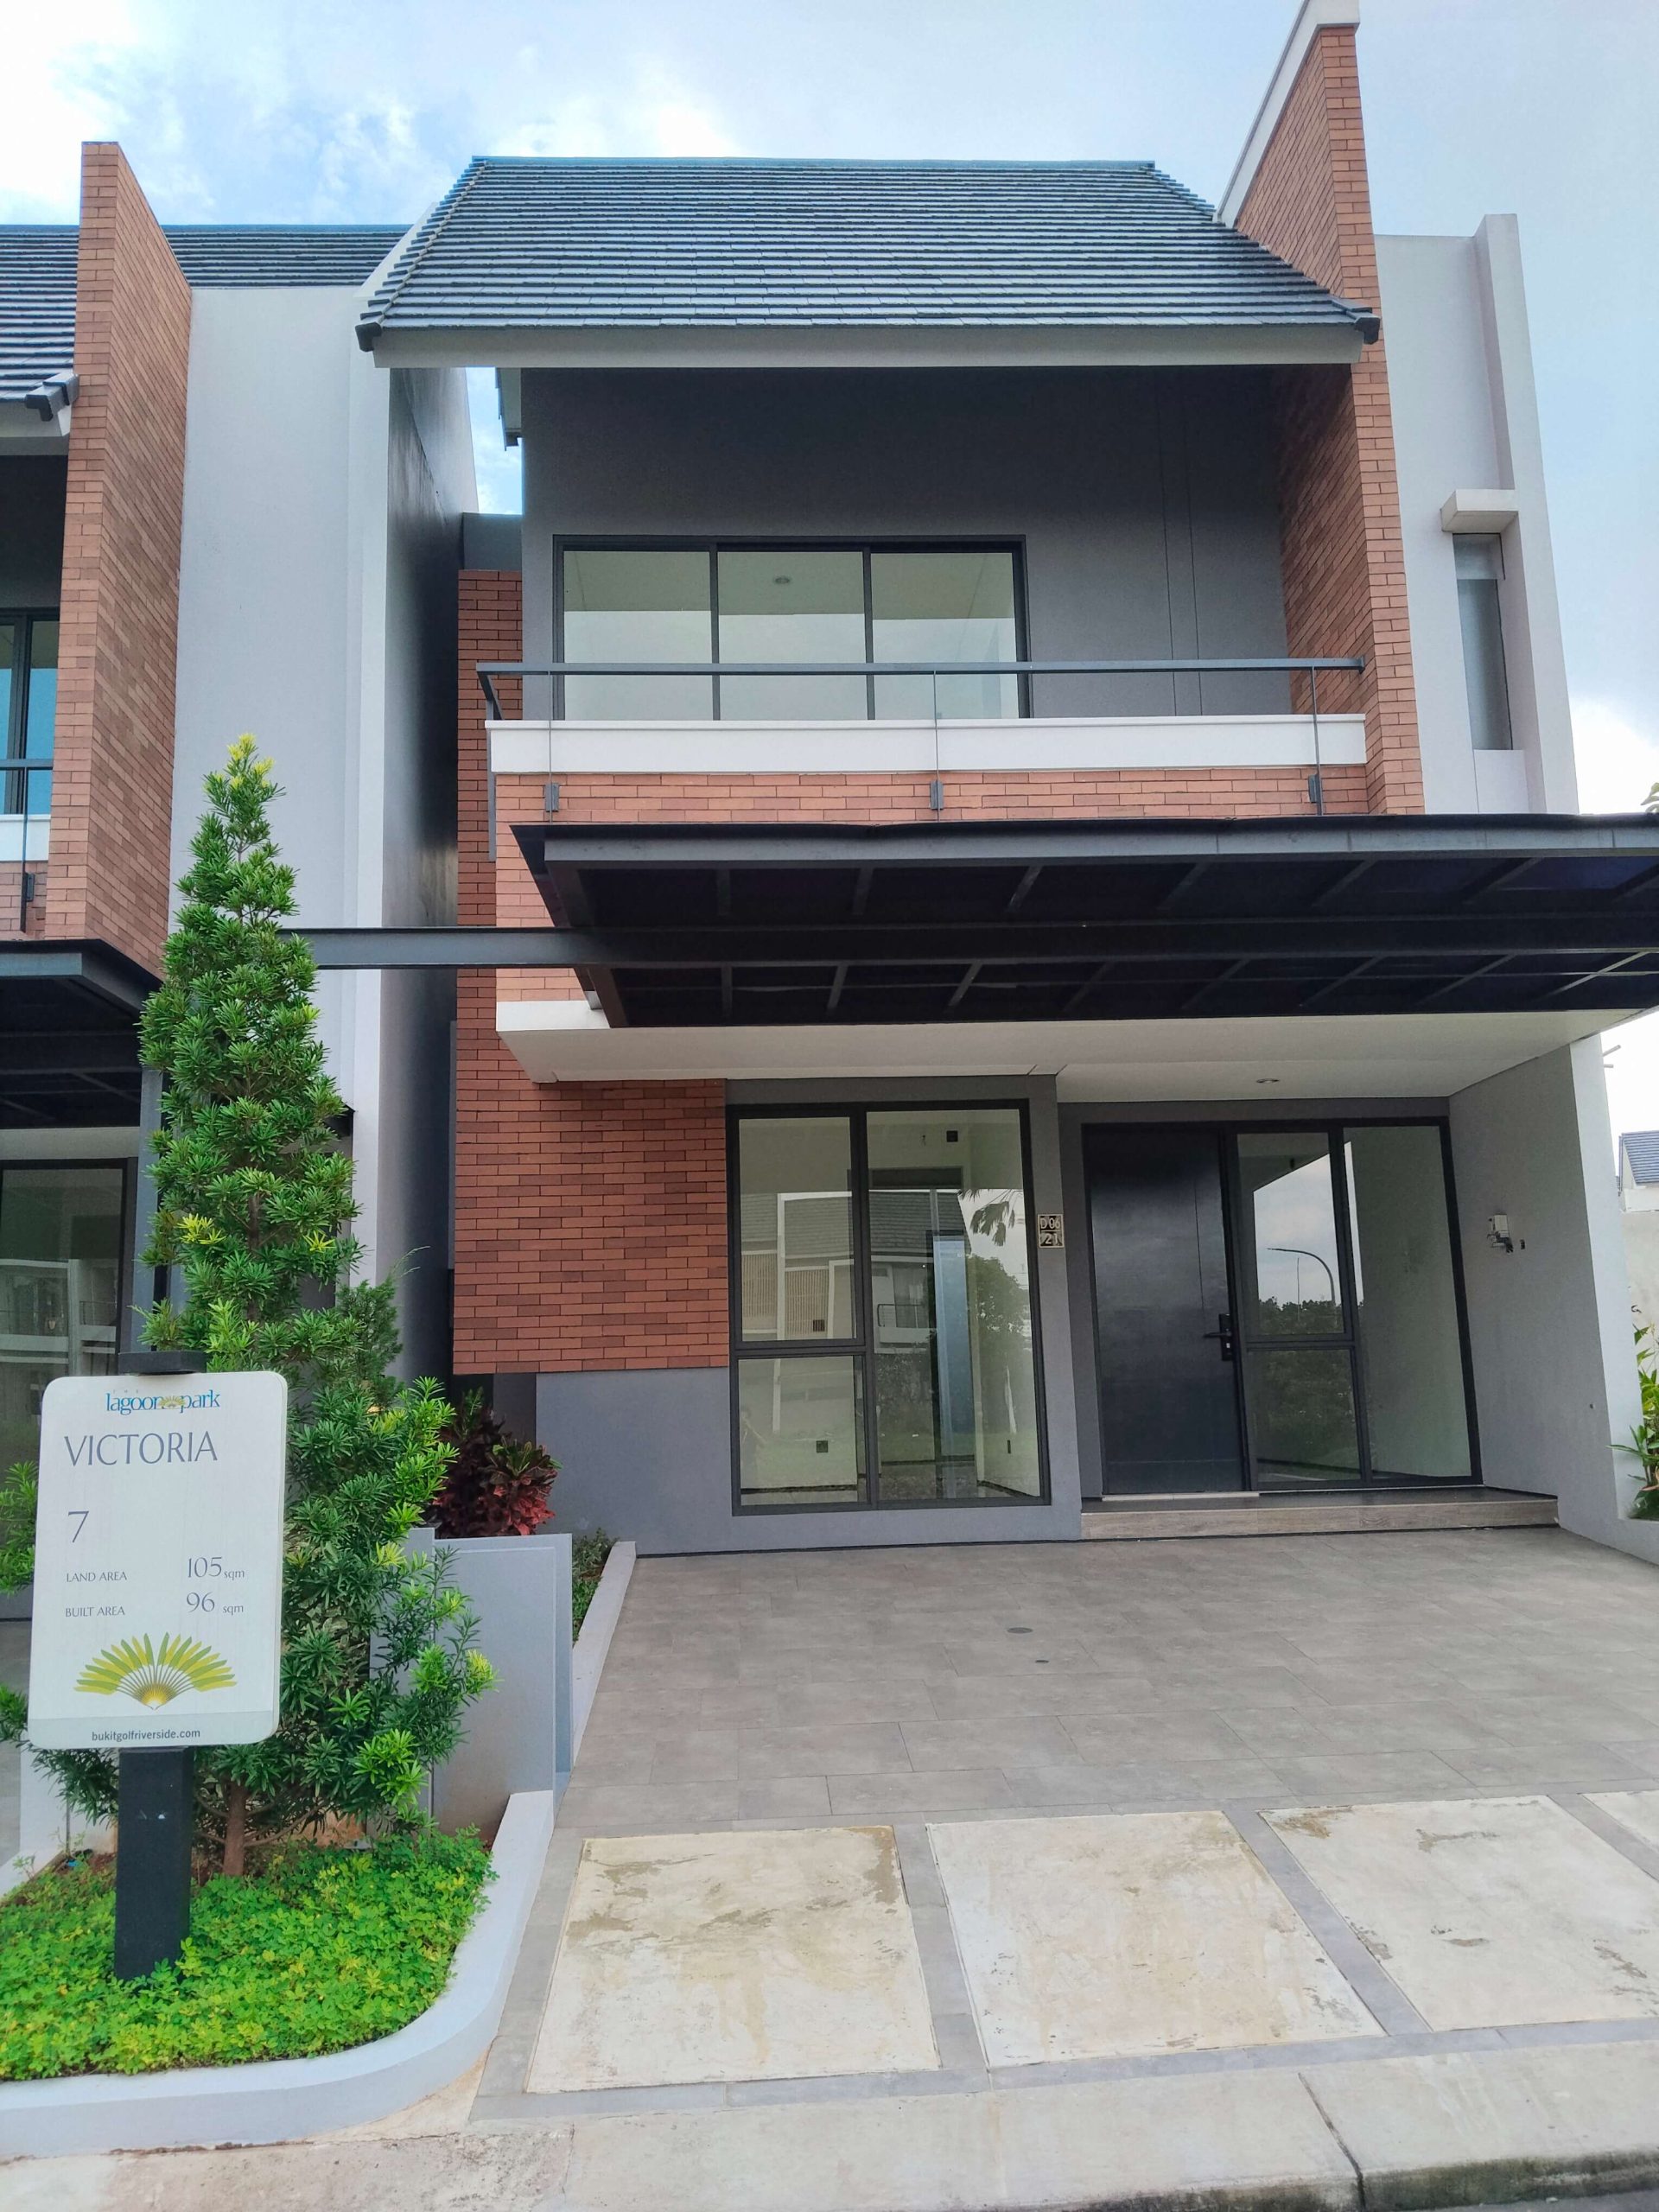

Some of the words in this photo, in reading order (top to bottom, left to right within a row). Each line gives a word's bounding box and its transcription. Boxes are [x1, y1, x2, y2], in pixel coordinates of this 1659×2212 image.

[180, 1389, 220, 1414] park
[64, 1431, 218, 1466] VICTORIA
[67, 1510, 89, 1543] 7
[67, 1573, 96, 1583] LAND
[99, 1571, 127, 1581] AREA
[188, 1556, 223, 1579] 105
[224, 1570, 245, 1580] sqm
[65, 1607, 94, 1618] BUILT
[97, 1605, 125, 1616] AREA
[187, 1592, 215, 1613] 96
[222, 1605, 244, 1616] sqm
[92, 1729, 200, 1742] bukitgolfriverside.com
